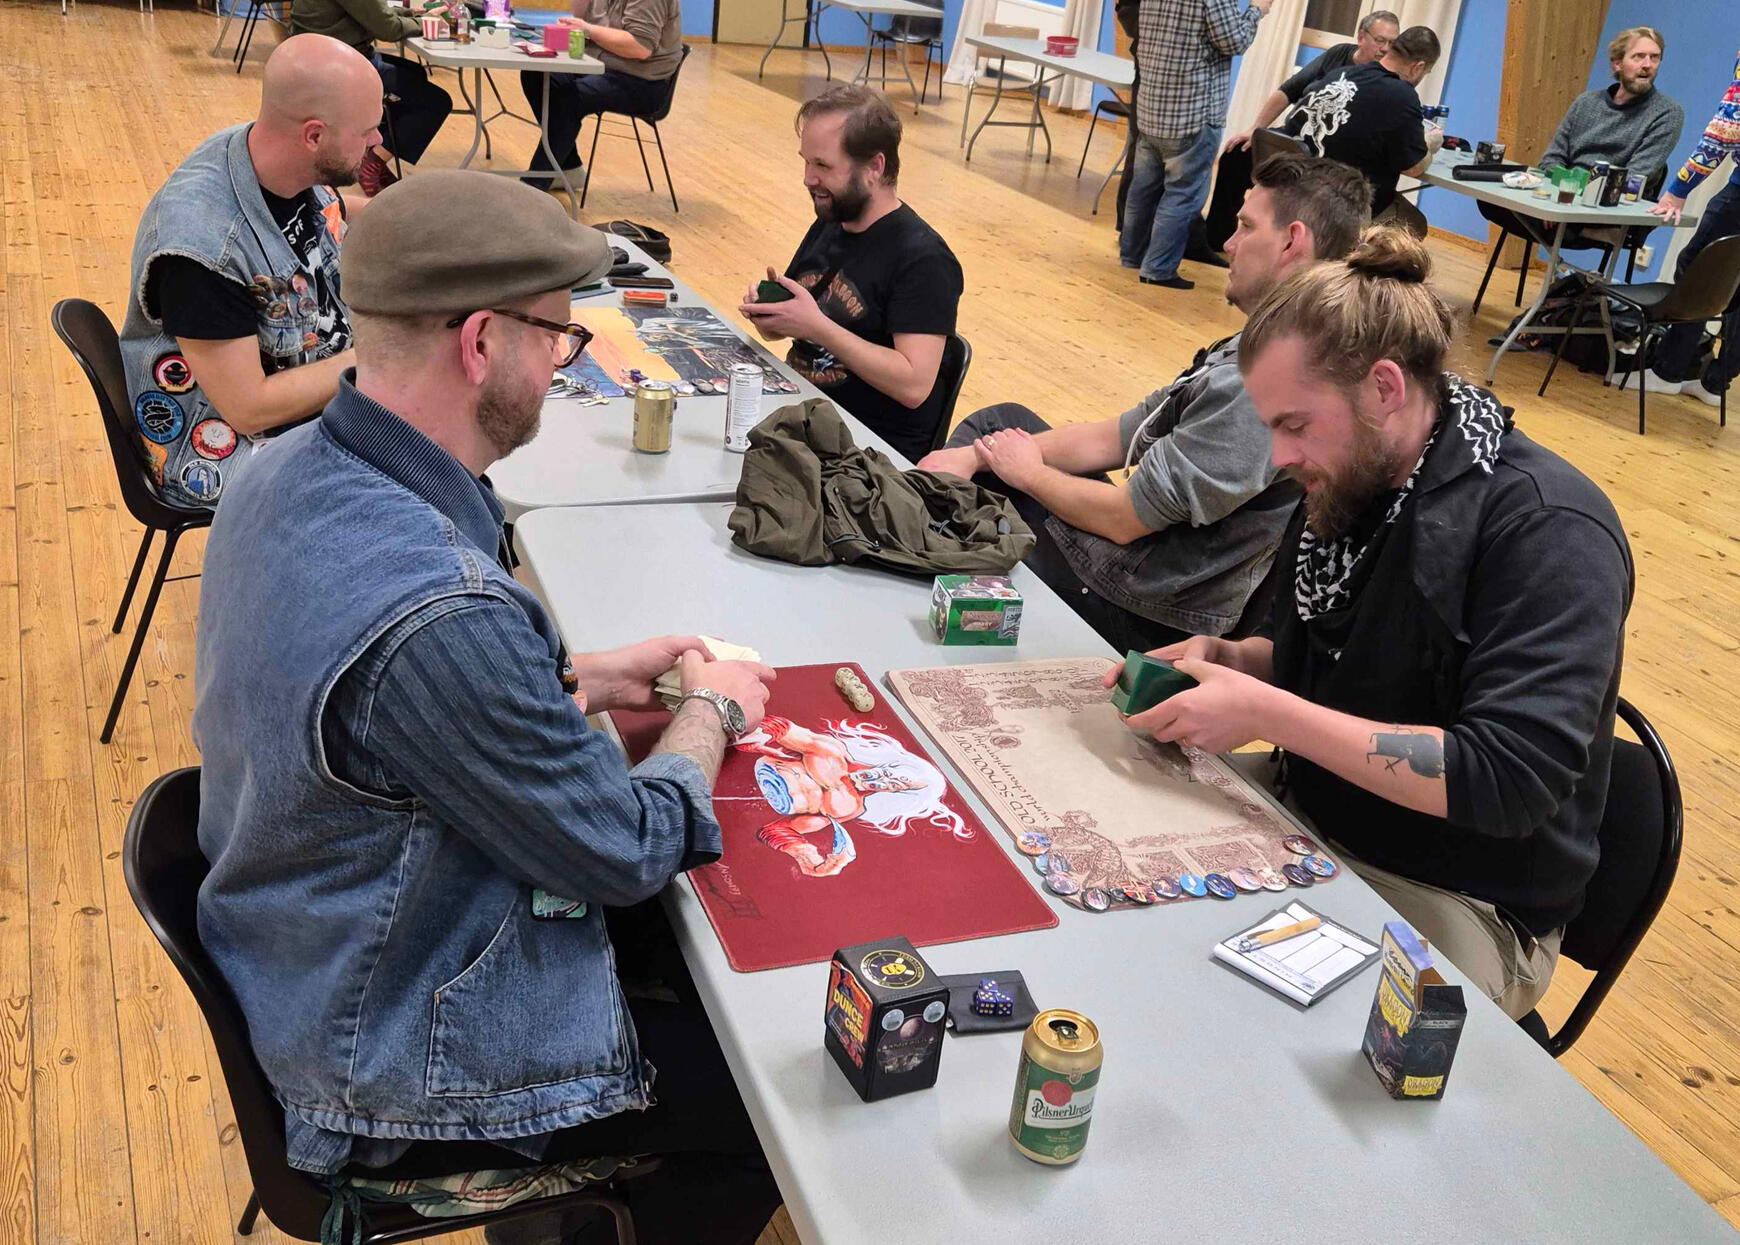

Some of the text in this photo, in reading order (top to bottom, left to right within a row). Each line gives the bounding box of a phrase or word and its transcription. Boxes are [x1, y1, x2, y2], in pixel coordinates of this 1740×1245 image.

[952, 734, 1036, 824] OLD SCHOOL 2017
[971, 733, 1051, 821] world championship
[833, 988, 864, 1030] DUNCE
[844, 1017, 865, 1043] CREW
[1031, 1097, 1070, 1119] Pilsner
